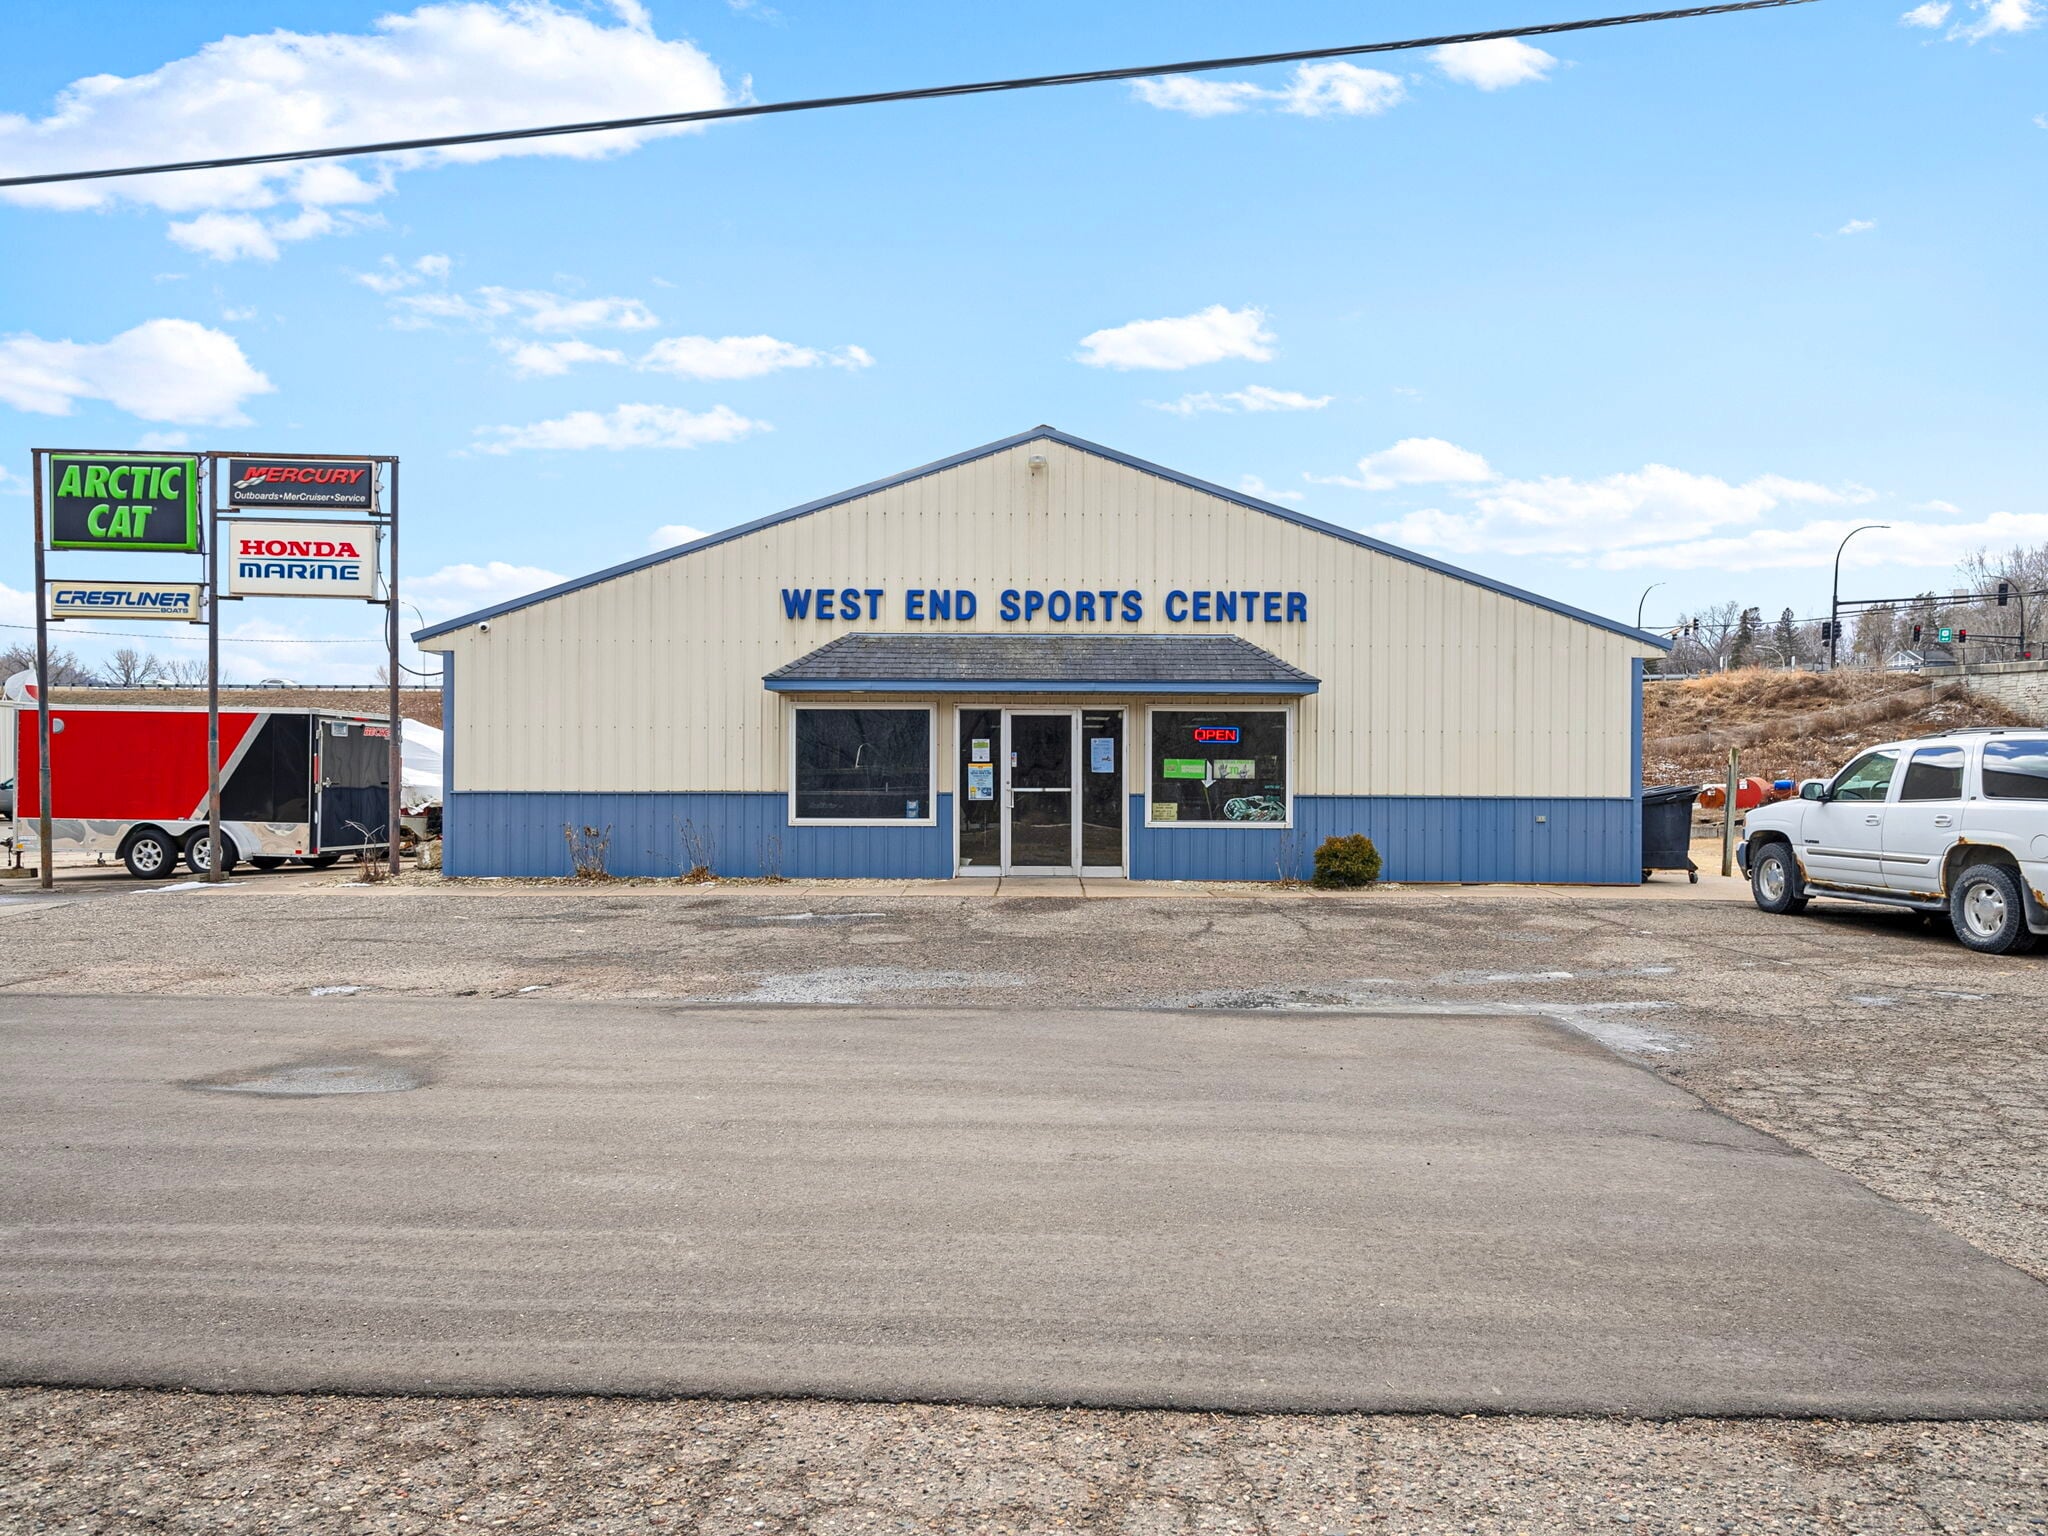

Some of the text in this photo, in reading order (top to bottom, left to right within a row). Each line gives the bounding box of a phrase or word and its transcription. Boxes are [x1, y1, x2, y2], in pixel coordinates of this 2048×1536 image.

[57, 465, 182, 500] ARCTIC
[243, 466, 365, 486] MERCURY
[234, 491, 366, 503] Outboards MerCruiser Service
[87, 504, 153, 539] CAT
[239, 540, 360, 558] HONDA
[239, 562, 360, 580] MARINE
[55, 590, 191, 607] CRESTLINER
[781, 588, 1308, 622] WEST END SPORTS CENTER
[1194, 729, 1236, 741] OPEN
